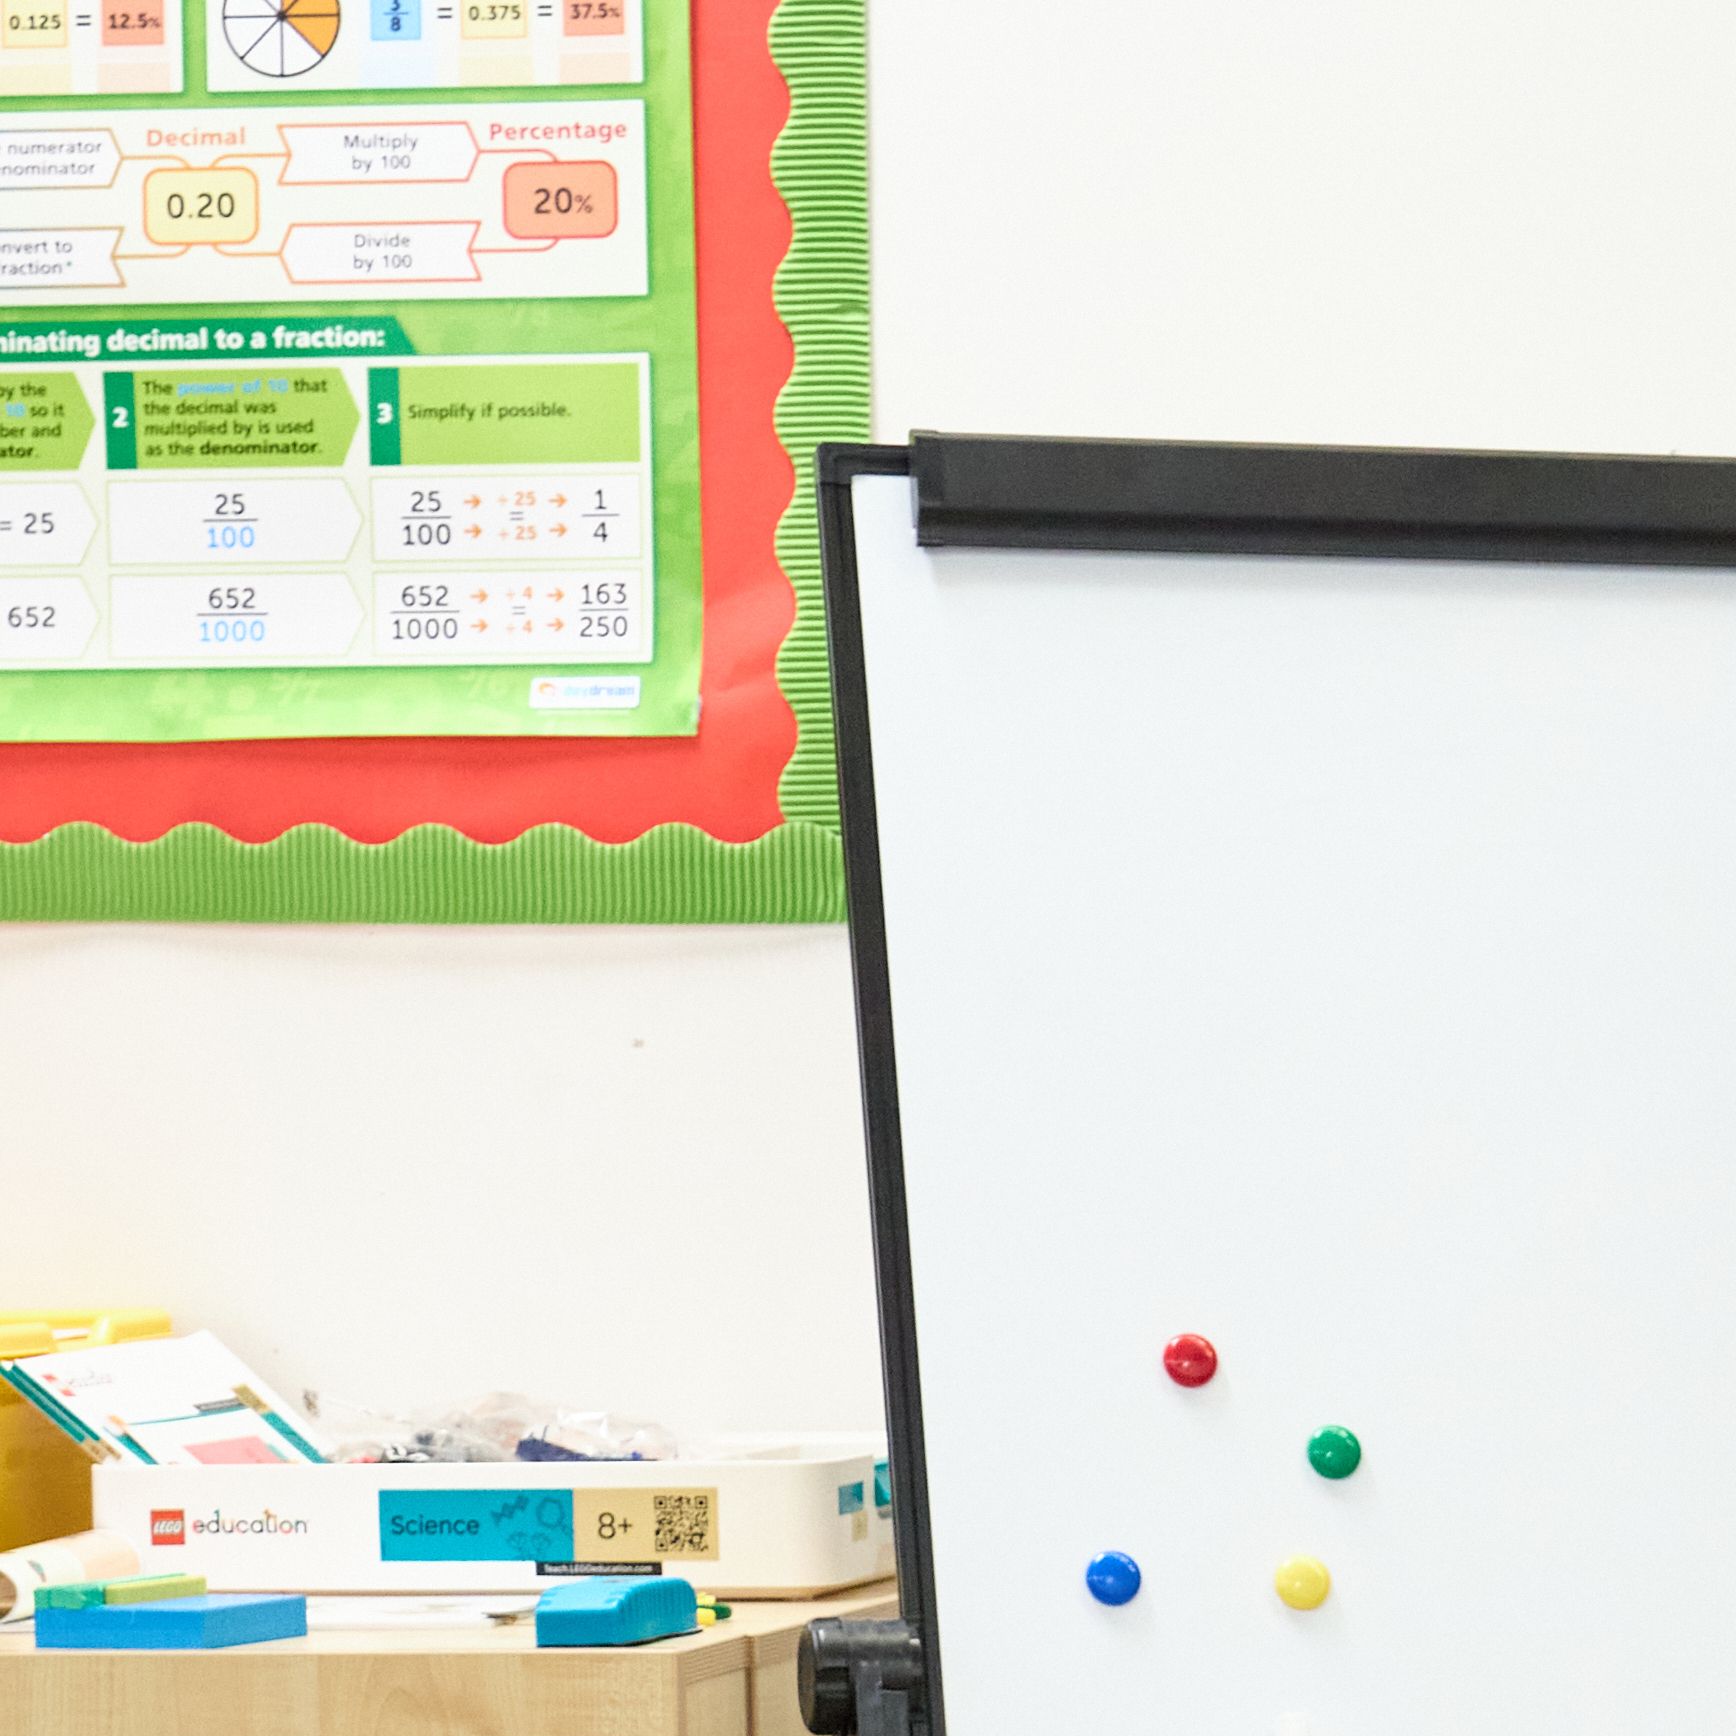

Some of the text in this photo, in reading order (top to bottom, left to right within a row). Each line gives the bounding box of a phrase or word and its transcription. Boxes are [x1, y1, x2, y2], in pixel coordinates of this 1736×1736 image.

[9, 14, 61, 30] 0.125
[109, 13, 160, 29] 12.5%
[469, 4, 521, 21] 0.375
[571, 3, 620, 20] 37.5%
[390, 17, 401, 32] 8
[146, 127, 246, 147] Decimal
[344, 133, 418, 151] Multiply
[489, 122, 627, 143] Percentage
[7, 141, 101, 156] numerator
[352, 155, 411, 172] by 100
[167, 192, 235, 219] 0.20
[534, 187, 593, 215] 20%
[55, 240, 72, 254] to
[354, 233, 410, 248] Divide
[353, 254, 412, 272] by 100
[107, 327, 208, 351] decimal
[214, 330, 244, 350] to
[250, 332, 266, 349] a
[272, 325, 385, 349] fraction:
[20, 382, 46, 397] the
[143, 381, 173, 396] The
[294, 378, 327, 393] that
[30, 405, 48, 417] so
[112, 407, 129, 428] 2
[144, 399, 277, 415] the decimal was
[377, 402, 392, 424] 3
[408, 402, 572, 421] Simplify if possible.
[32, 422, 62, 438] and
[144, 418, 313, 438] multiplied by is used
[146, 439, 321, 457] as the denominator.
[215, 493, 245, 515] 25
[411, 490, 441, 513] 25
[515, 491, 536, 506] 25
[594, 489, 607, 510] 1
[24, 512, 55, 535] 25
[516, 526, 536, 541] 25
[593, 522, 608, 543] 4
[207, 526, 255, 549] 100
[403, 523, 451, 546] 100
[208, 587, 255, 610] 652
[401, 585, 449, 607] 652
[581, 583, 628, 605] 163
[8, 606, 56, 628] 652
[579, 616, 628, 638] 250
[200, 620, 265, 642] 1000
[392, 618, 458, 640] 1000
[153, 1509, 308, 1536] LEGO education
[391, 1513, 480, 1536] Science
[597, 1511, 633, 1540] 8+
